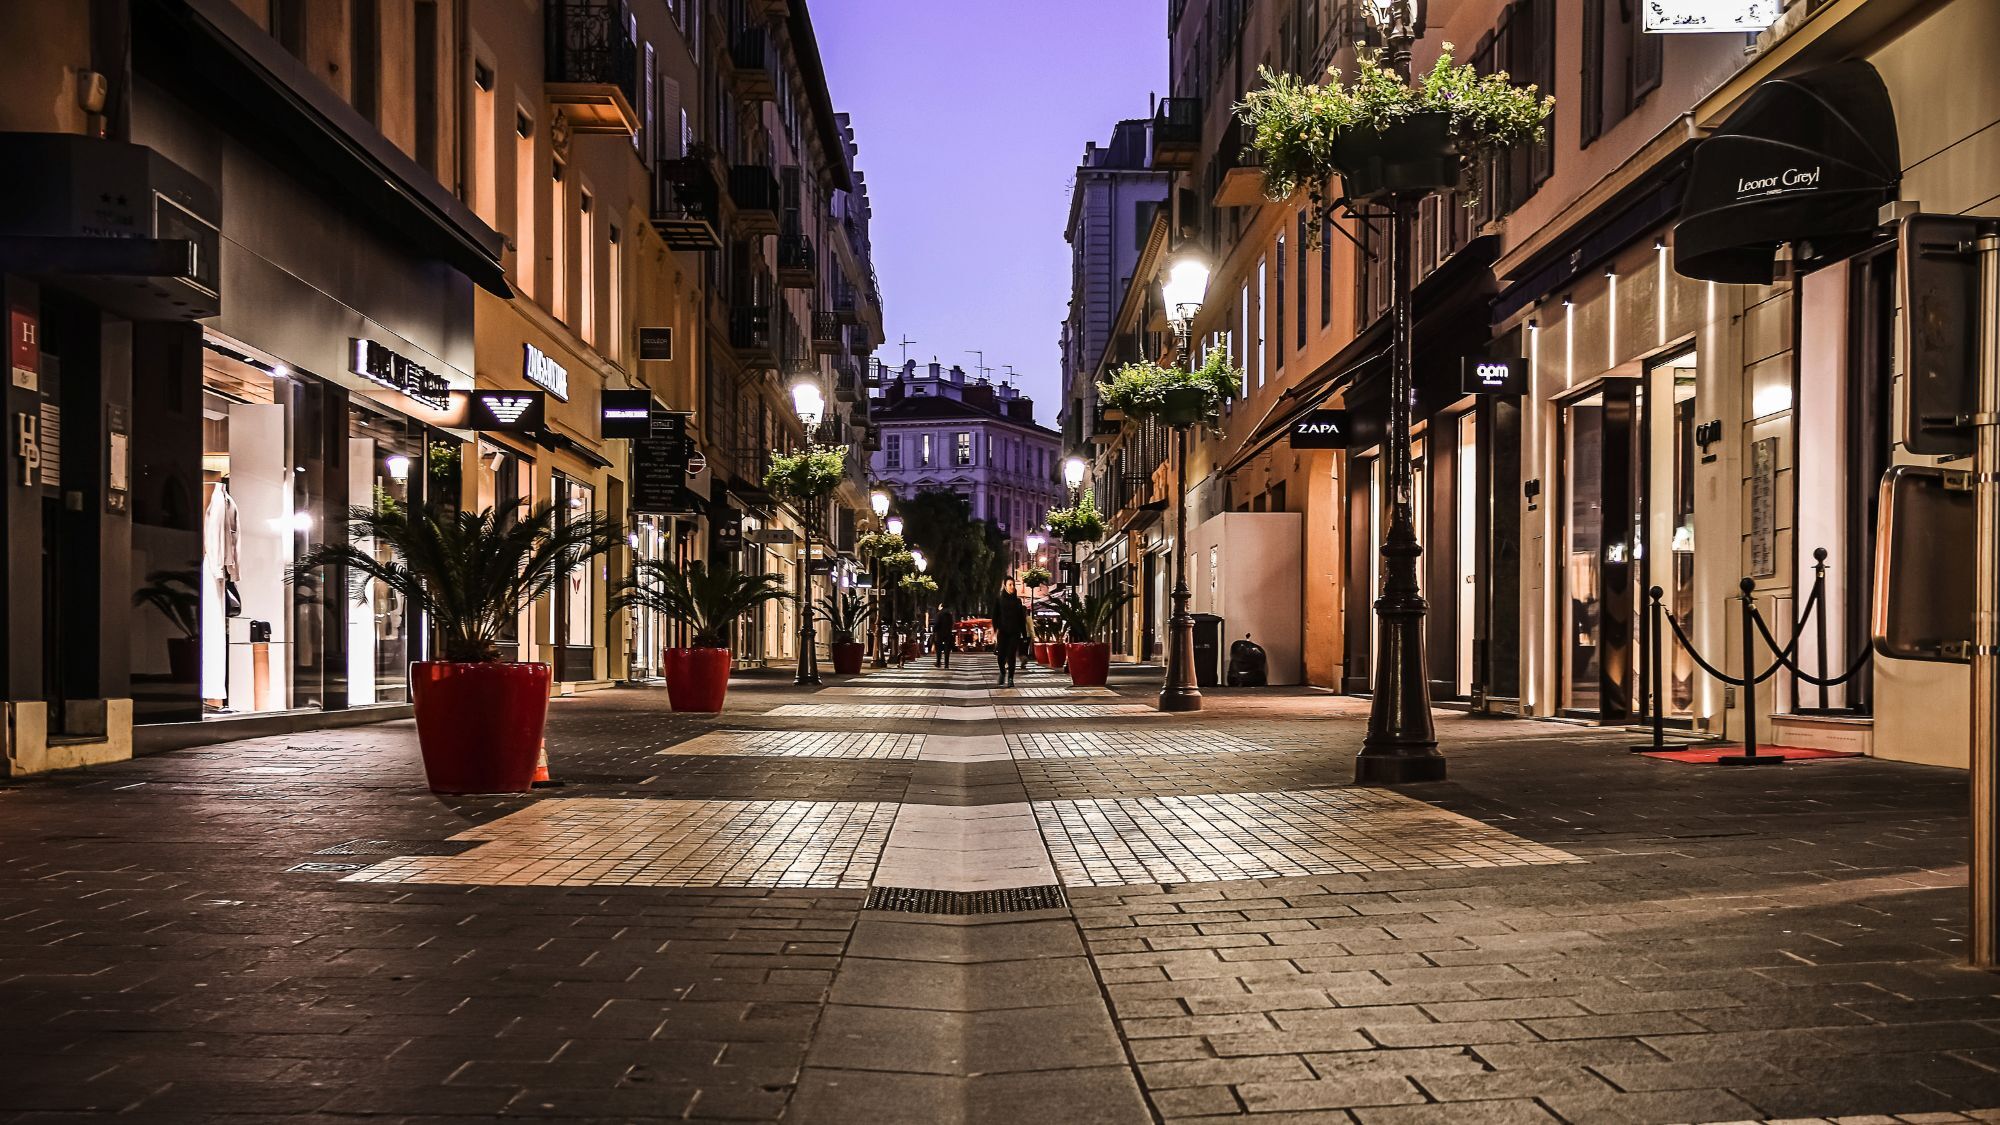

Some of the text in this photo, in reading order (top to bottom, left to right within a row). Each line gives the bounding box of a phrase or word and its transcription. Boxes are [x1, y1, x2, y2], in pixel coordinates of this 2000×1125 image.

[1737, 166, 1820, 193] Leonor Greyl
[22, 321, 36, 345] H
[1476, 364, 1509, 381] apm
[1297, 423, 1340, 434] ZAPA
